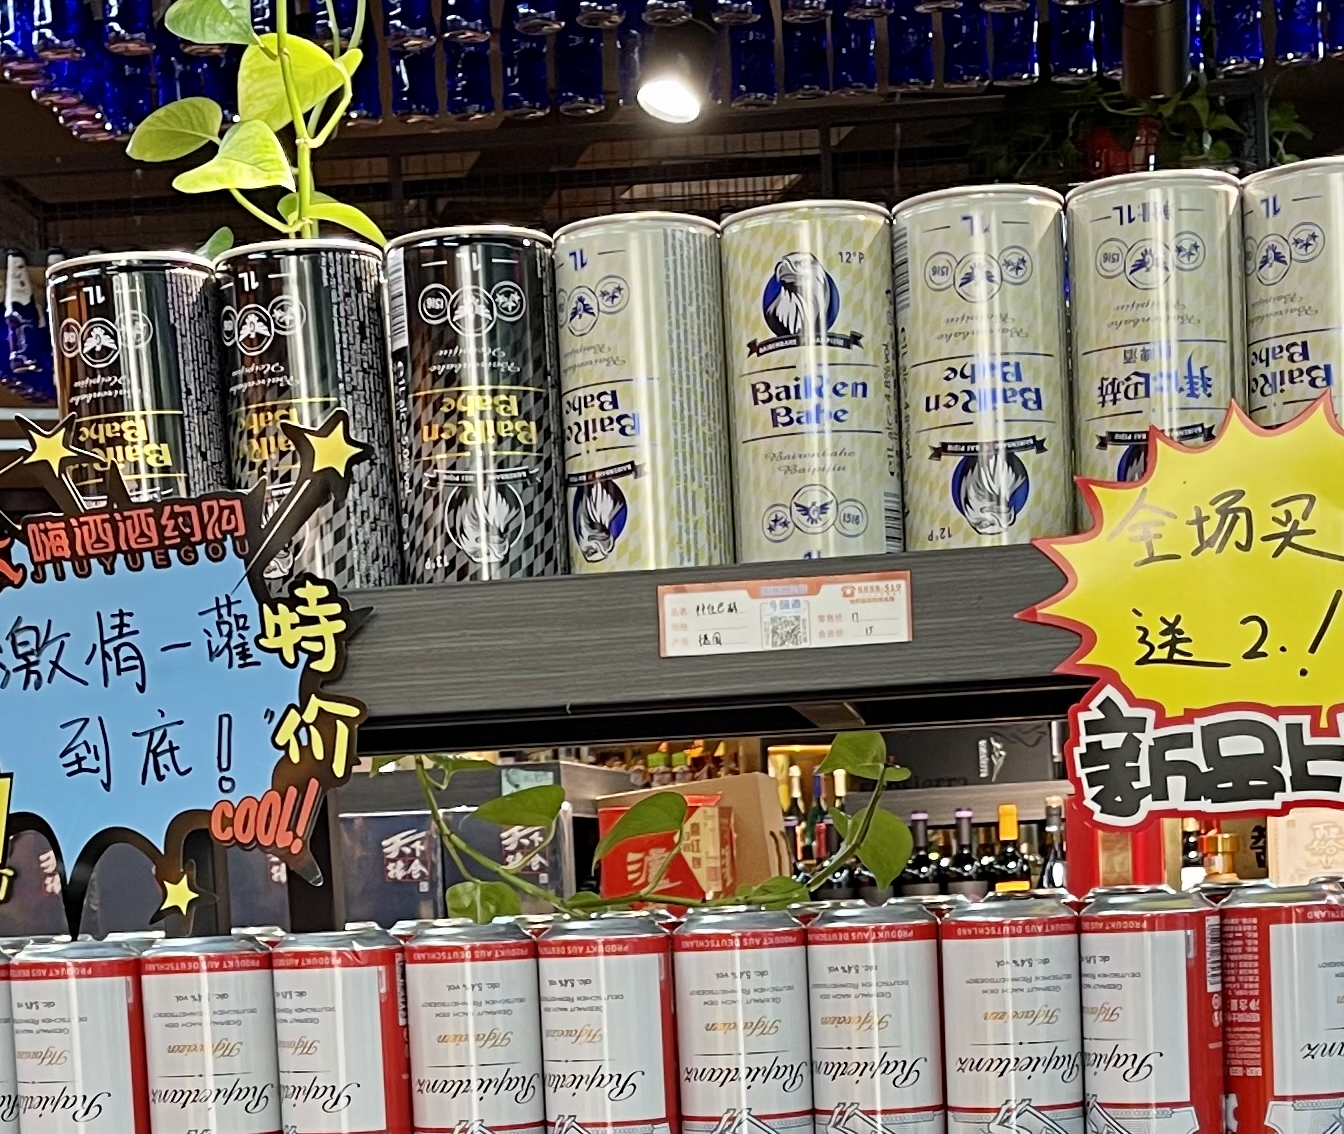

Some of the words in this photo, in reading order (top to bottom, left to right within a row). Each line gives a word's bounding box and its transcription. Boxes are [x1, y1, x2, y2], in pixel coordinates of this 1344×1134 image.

[1259, 196, 1280, 220] 1L
[567, 249, 588, 271] 1L
[238, 270, 260, 289] 1L
[752, 376, 869, 406] BaiRen
[924, 385, 1044, 413] BaiRen
[421, 419, 538, 446] BaiRen
[258, 580, 361, 777] 特价
[211, 778, 319, 855] COOL!
[683, 1055, 803, 1093] Rapiertanz
[955, 1045, 1082, 1084] Rapiertanz
[150, 1078, 273, 1115] Rapiertanz
[416, 1066, 540, 1105] Rapiertanz
